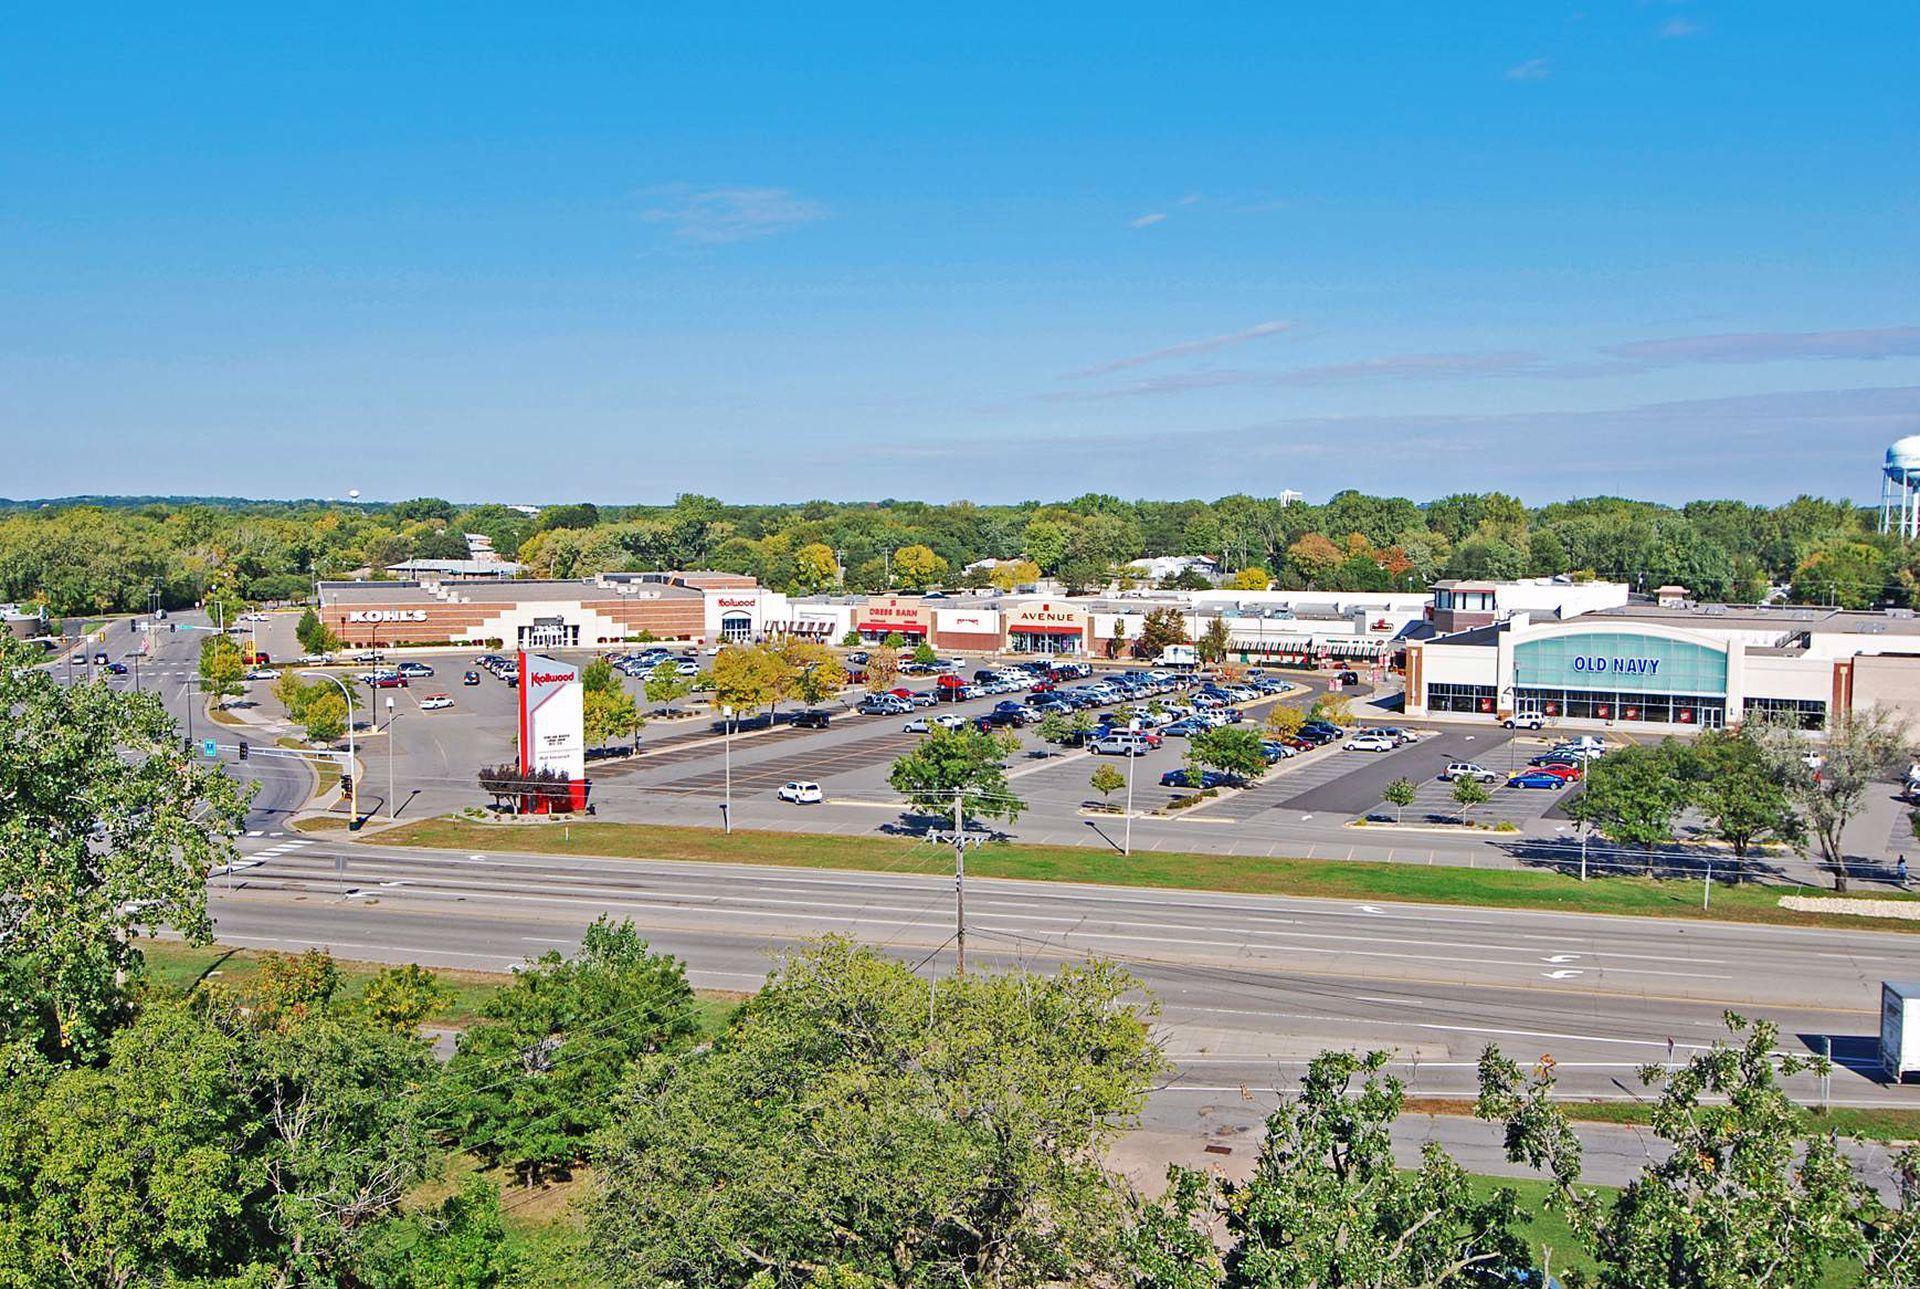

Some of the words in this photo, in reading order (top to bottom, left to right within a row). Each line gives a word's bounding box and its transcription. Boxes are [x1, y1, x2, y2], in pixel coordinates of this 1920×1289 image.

[869, 608, 893, 616] DRESS
[896, 609, 918, 617] BARN
[1021, 612, 1074, 621] AVENUE
[1574, 656, 1607, 672] OLD
[1613, 658, 1660, 674] NAVY
